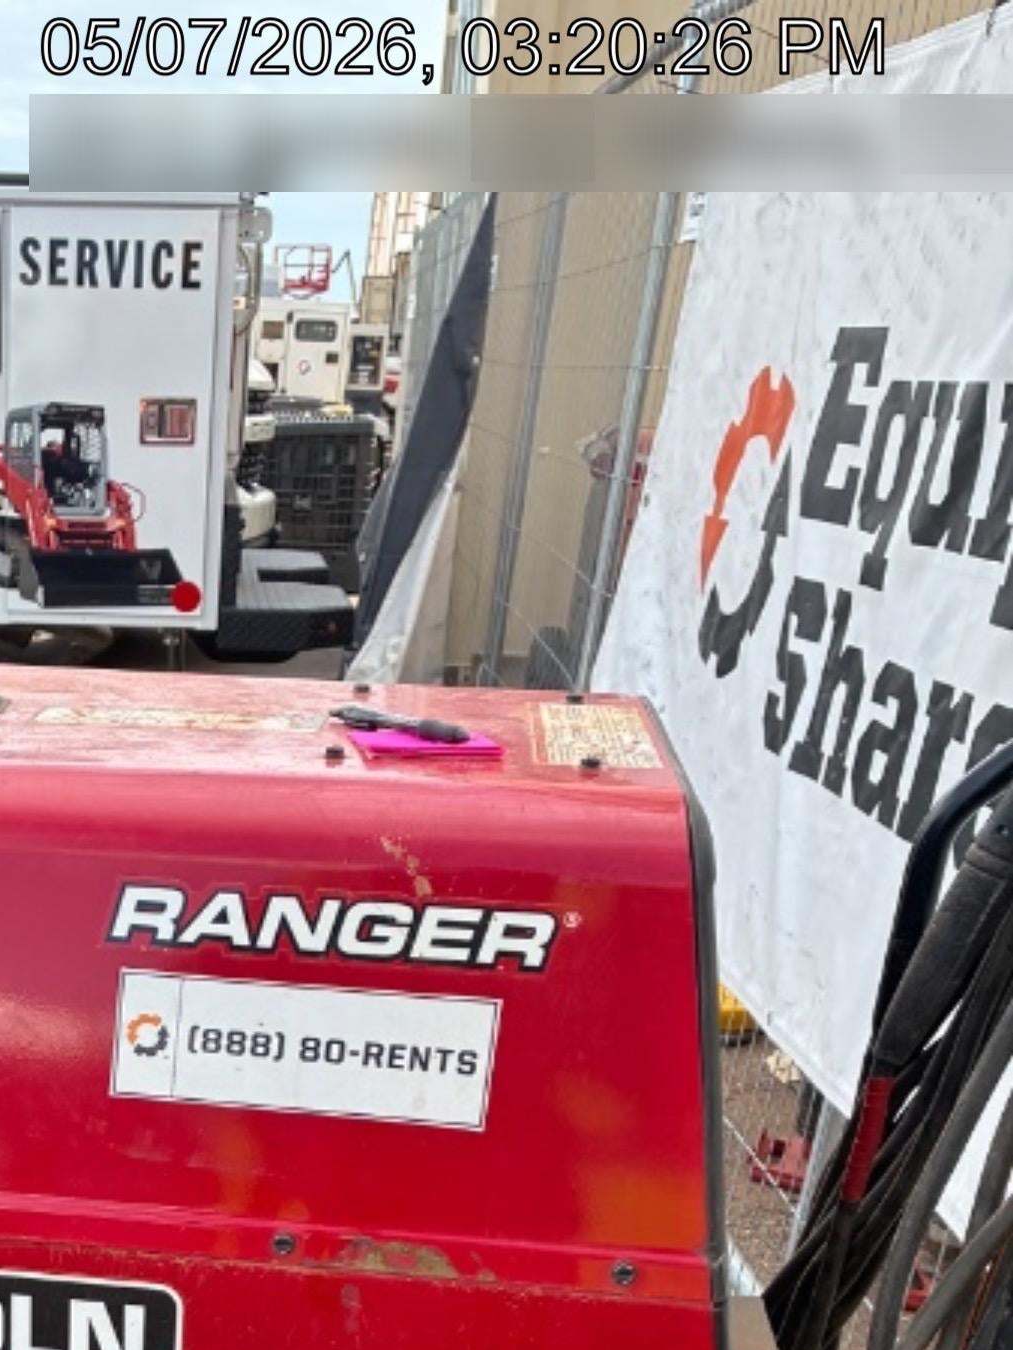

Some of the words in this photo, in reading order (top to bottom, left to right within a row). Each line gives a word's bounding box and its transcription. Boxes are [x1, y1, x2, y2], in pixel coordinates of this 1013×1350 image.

[19, 237, 203, 290] SERVICE
[108, 884, 558, 971] RANGER
[187, 1025, 286, 1063] (888)
[299, 1037, 478, 1076] 80-RENTS
